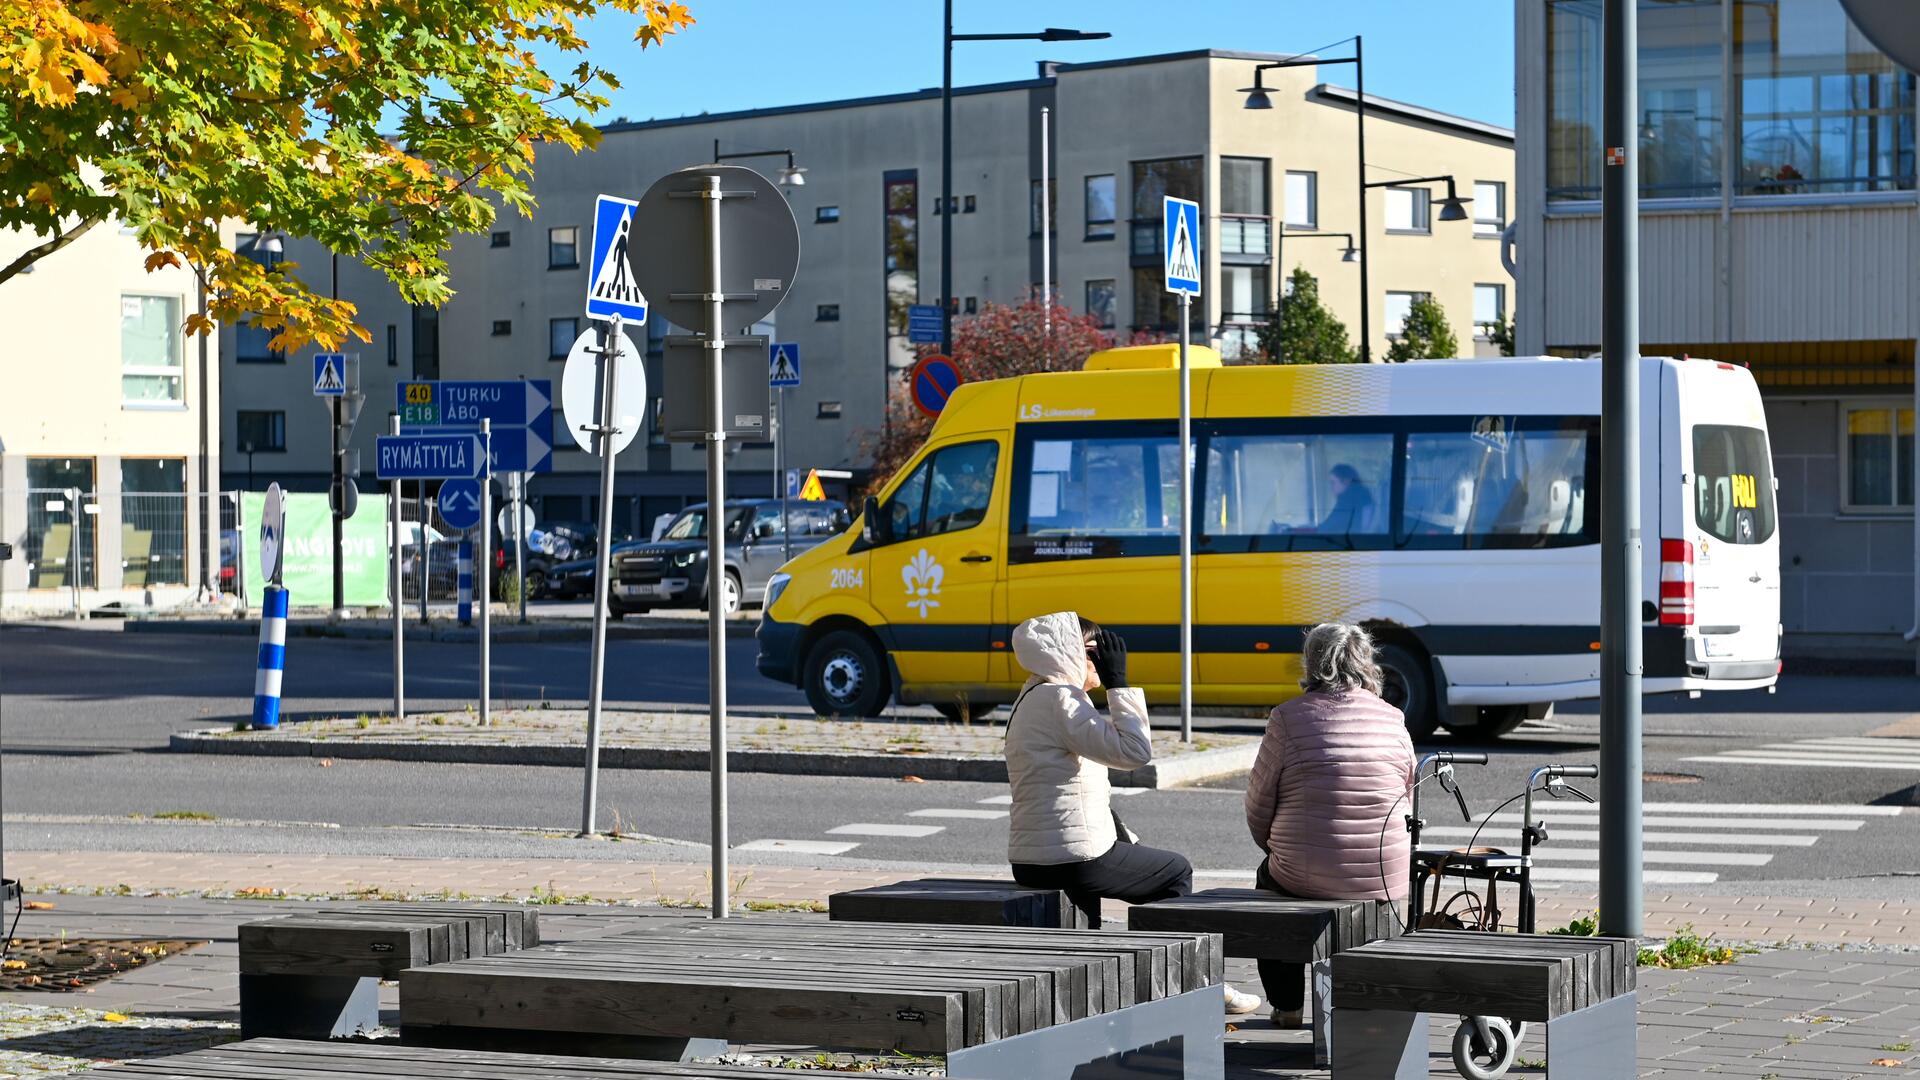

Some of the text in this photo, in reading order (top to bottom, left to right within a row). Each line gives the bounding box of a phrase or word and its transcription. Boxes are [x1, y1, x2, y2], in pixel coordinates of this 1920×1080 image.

[409, 387, 428, 400] 40
[446, 387, 501, 402] TURKU
[405, 407, 432, 421] E18
[447, 404, 479, 420] ÅBO
[382, 441, 466, 470] RYMÄTTYLÄ
[831, 568, 864, 589] 2064
